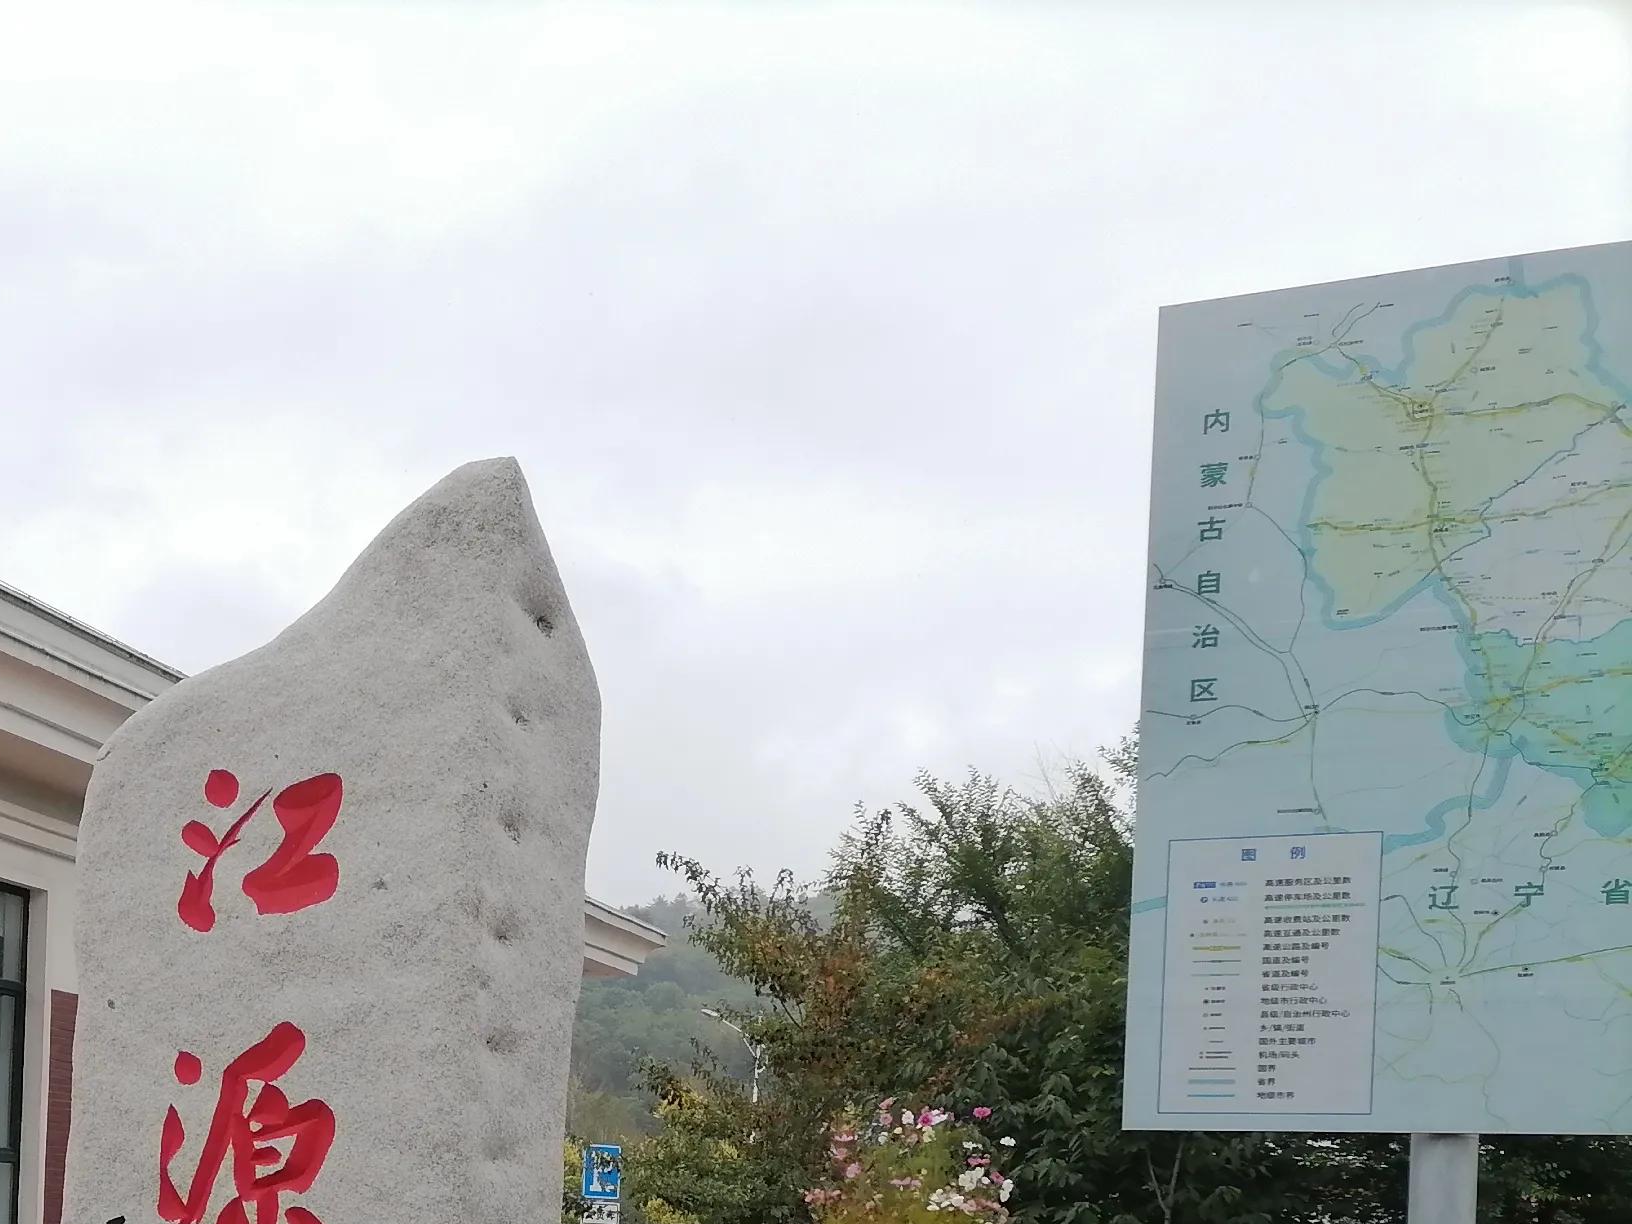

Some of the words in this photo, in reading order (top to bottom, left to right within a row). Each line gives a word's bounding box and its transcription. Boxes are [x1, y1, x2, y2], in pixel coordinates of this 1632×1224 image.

[1190, 408, 1231, 703] 内蒙古自治区
[1428, 878, 1632, 910] 辽宁省
